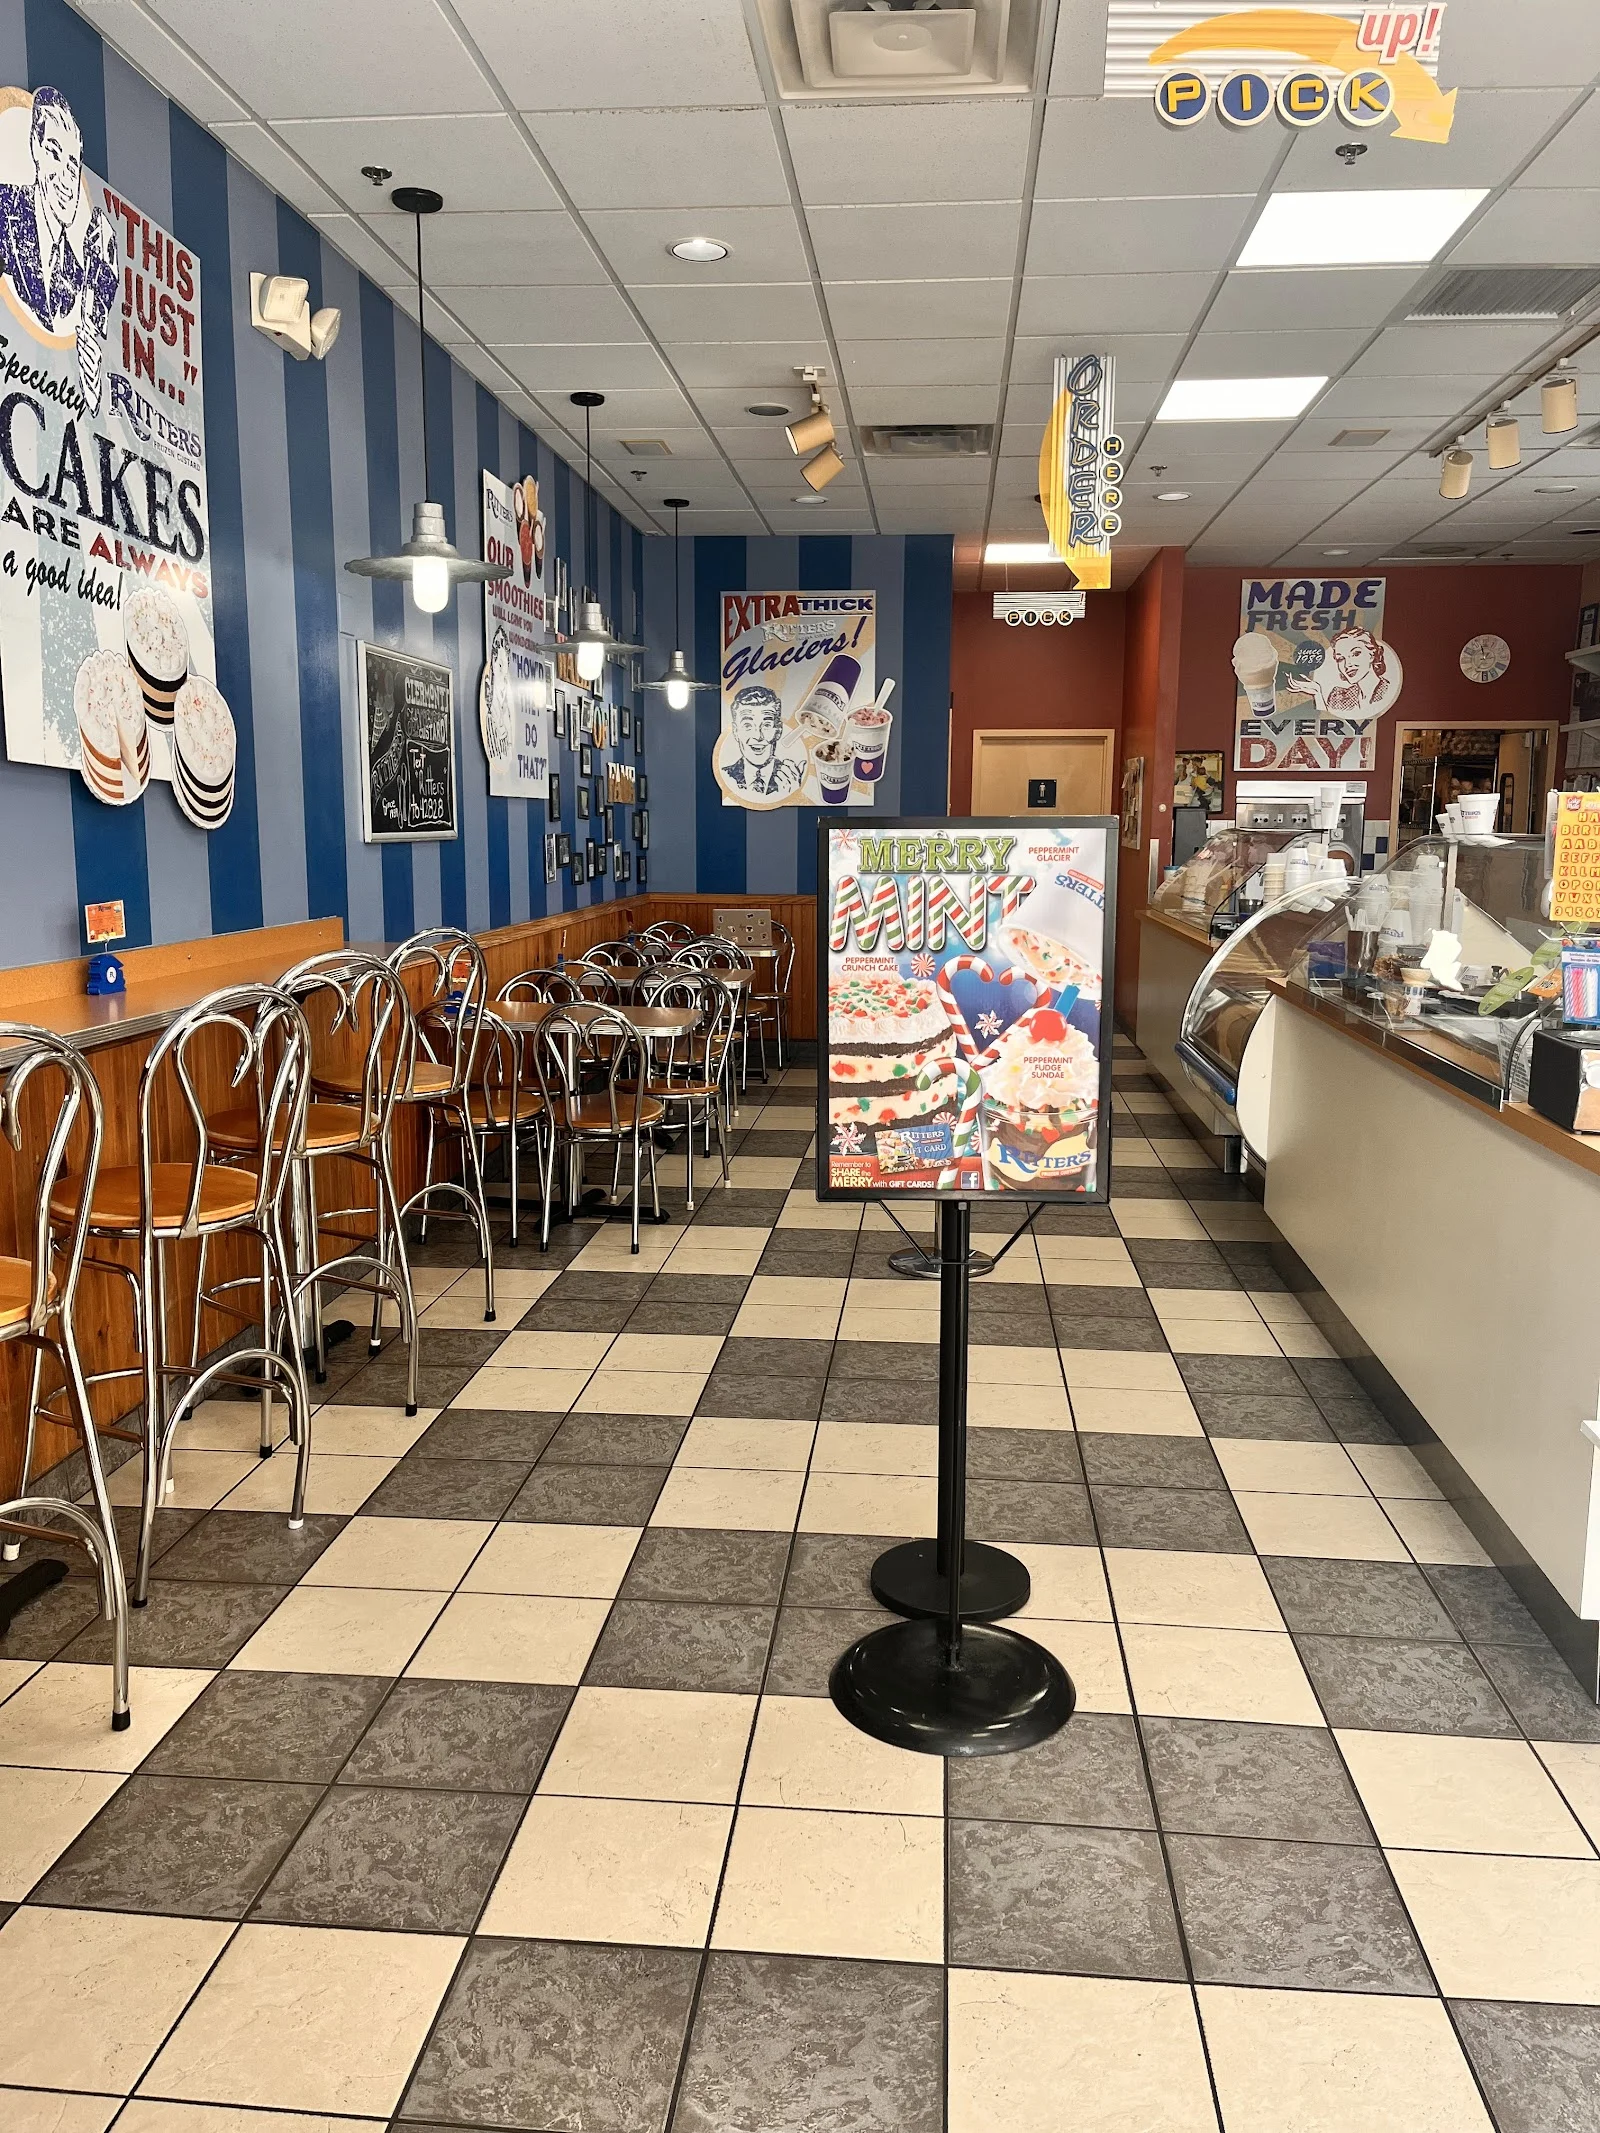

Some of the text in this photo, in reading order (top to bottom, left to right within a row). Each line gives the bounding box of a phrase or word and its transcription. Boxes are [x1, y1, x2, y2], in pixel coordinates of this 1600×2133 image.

[1361, 6, 1441, 62] up!
[1165, 76, 1388, 115] PICK
[0, 335, 86, 422] Specialty
[1067, 354, 1103, 548] ORDER
[0, 391, 205, 563] CAKES
[1103, 437, 1121, 533] HERE
[1, 496, 209, 599] ARE ALWAYS
[487, 536, 514, 572] OUR
[3, 550, 123, 611] a good idea!
[1247, 580, 1383, 610] MADE
[488, 580, 544, 621] SMOOTHIES
[723, 595, 874, 652] EXTRA THICK
[1008, 611, 1070, 623] PICK
[1245, 609, 1358, 634] FRESH
[722, 616, 868, 692] Glaciers!
[525, 722, 538, 749] DO
[1240, 719, 1374, 736] EVERY
[1239, 737, 1373, 770] DAY!
[420, 797, 444, 820] 42828
[858, 836, 1016, 874] MERRY
[1028, 847, 1080, 855] PEPPERMINT
[1036, 854, 1071, 862] GLACIER
[829, 875, 1036, 951] MINT
[841, 964, 899, 972] CRUNCH CAKE
[845, 956, 895, 964] PEPPERMINT
[1023, 1056, 1073, 1065] PEPPERMINT
[1031, 1071, 1065, 1079] SUNDAE
[1034, 1064, 1062, 1072] FUDGE
[902, 1143, 947, 1155] GIFT CARD
[831, 1168, 860, 1177] SHARE
[831, 1176, 873, 1187] MERRY
[889, 1180, 905, 1188] GIFT
[907, 1180, 934, 1188] CARDS!
